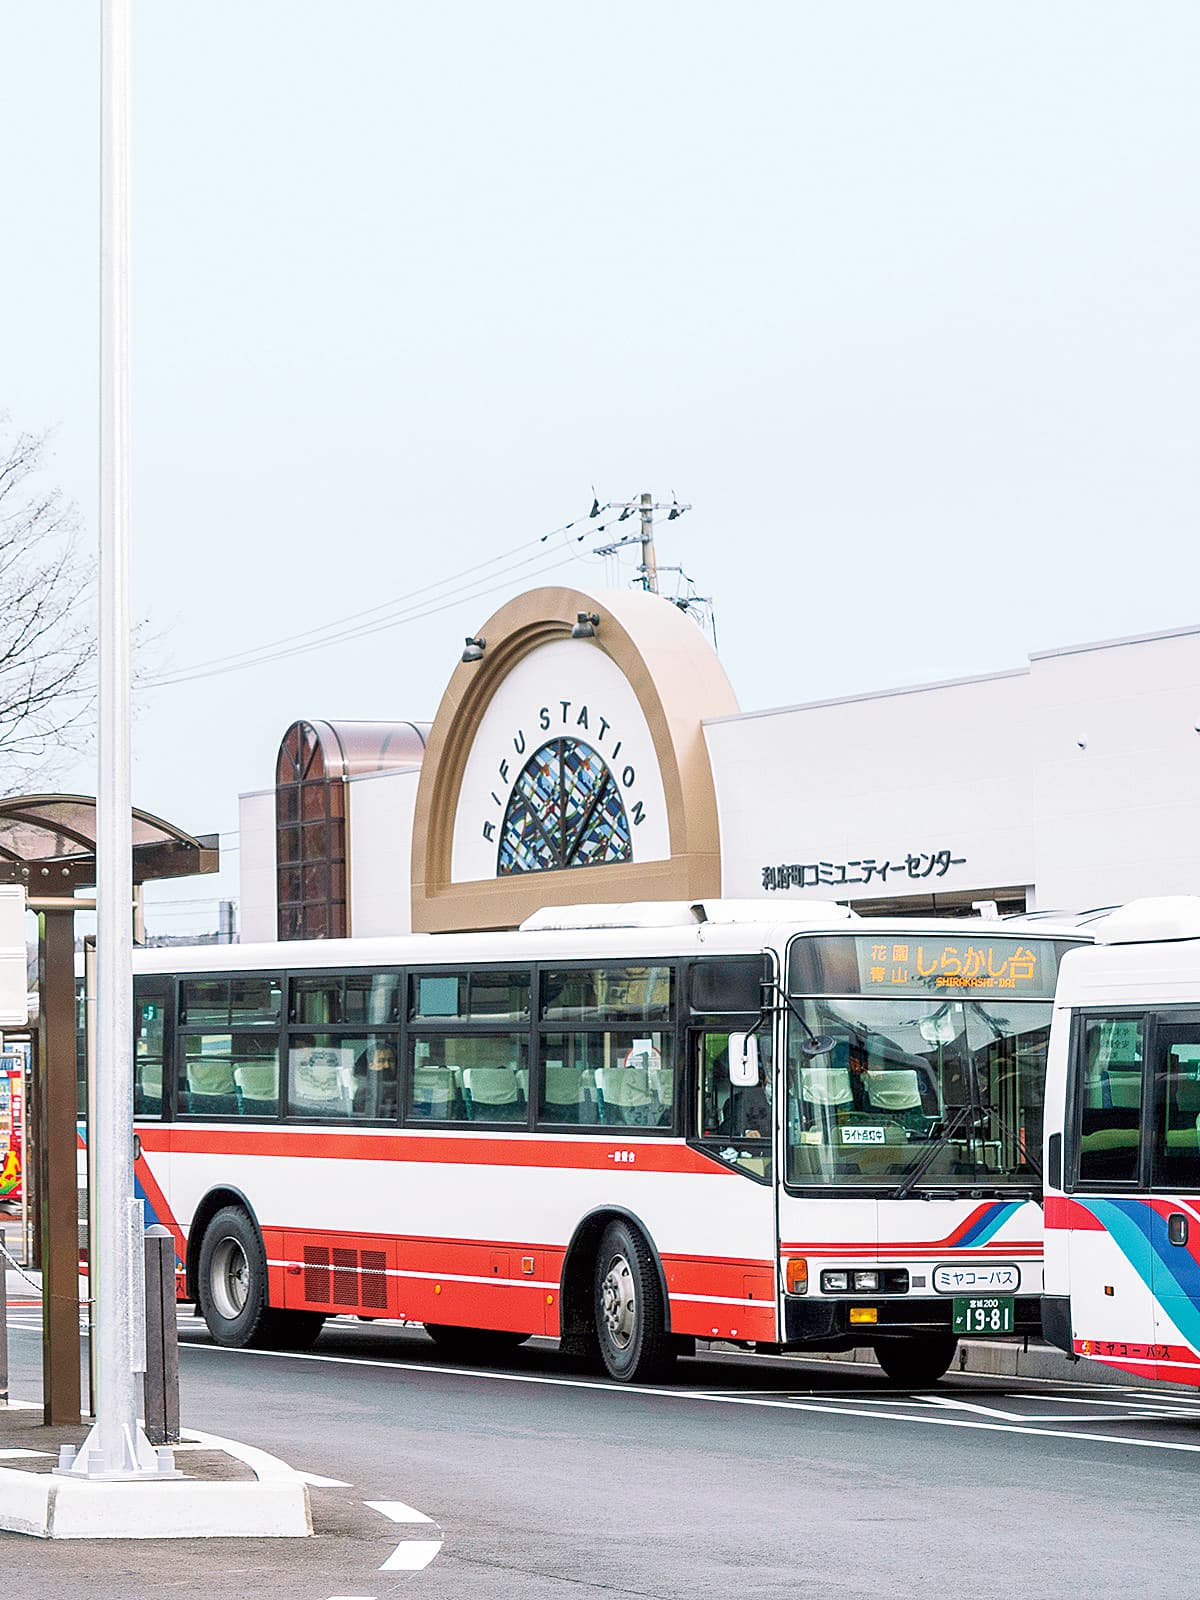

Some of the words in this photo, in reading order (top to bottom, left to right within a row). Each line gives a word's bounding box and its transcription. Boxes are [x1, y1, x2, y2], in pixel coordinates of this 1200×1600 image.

[482, 730, 526, 843] RIFU
[539, 700, 647, 827] STATION
[761, 850, 967, 891] 利府町コミュニティーセンター
[916, 946, 1037, 979] しらかし台
[940, 1271, 1013, 1286] ミヤコーバス
[966, 1307, 1009, 1331] 19-81
[1094, 1341, 1171, 1359] ミヤコーバス
